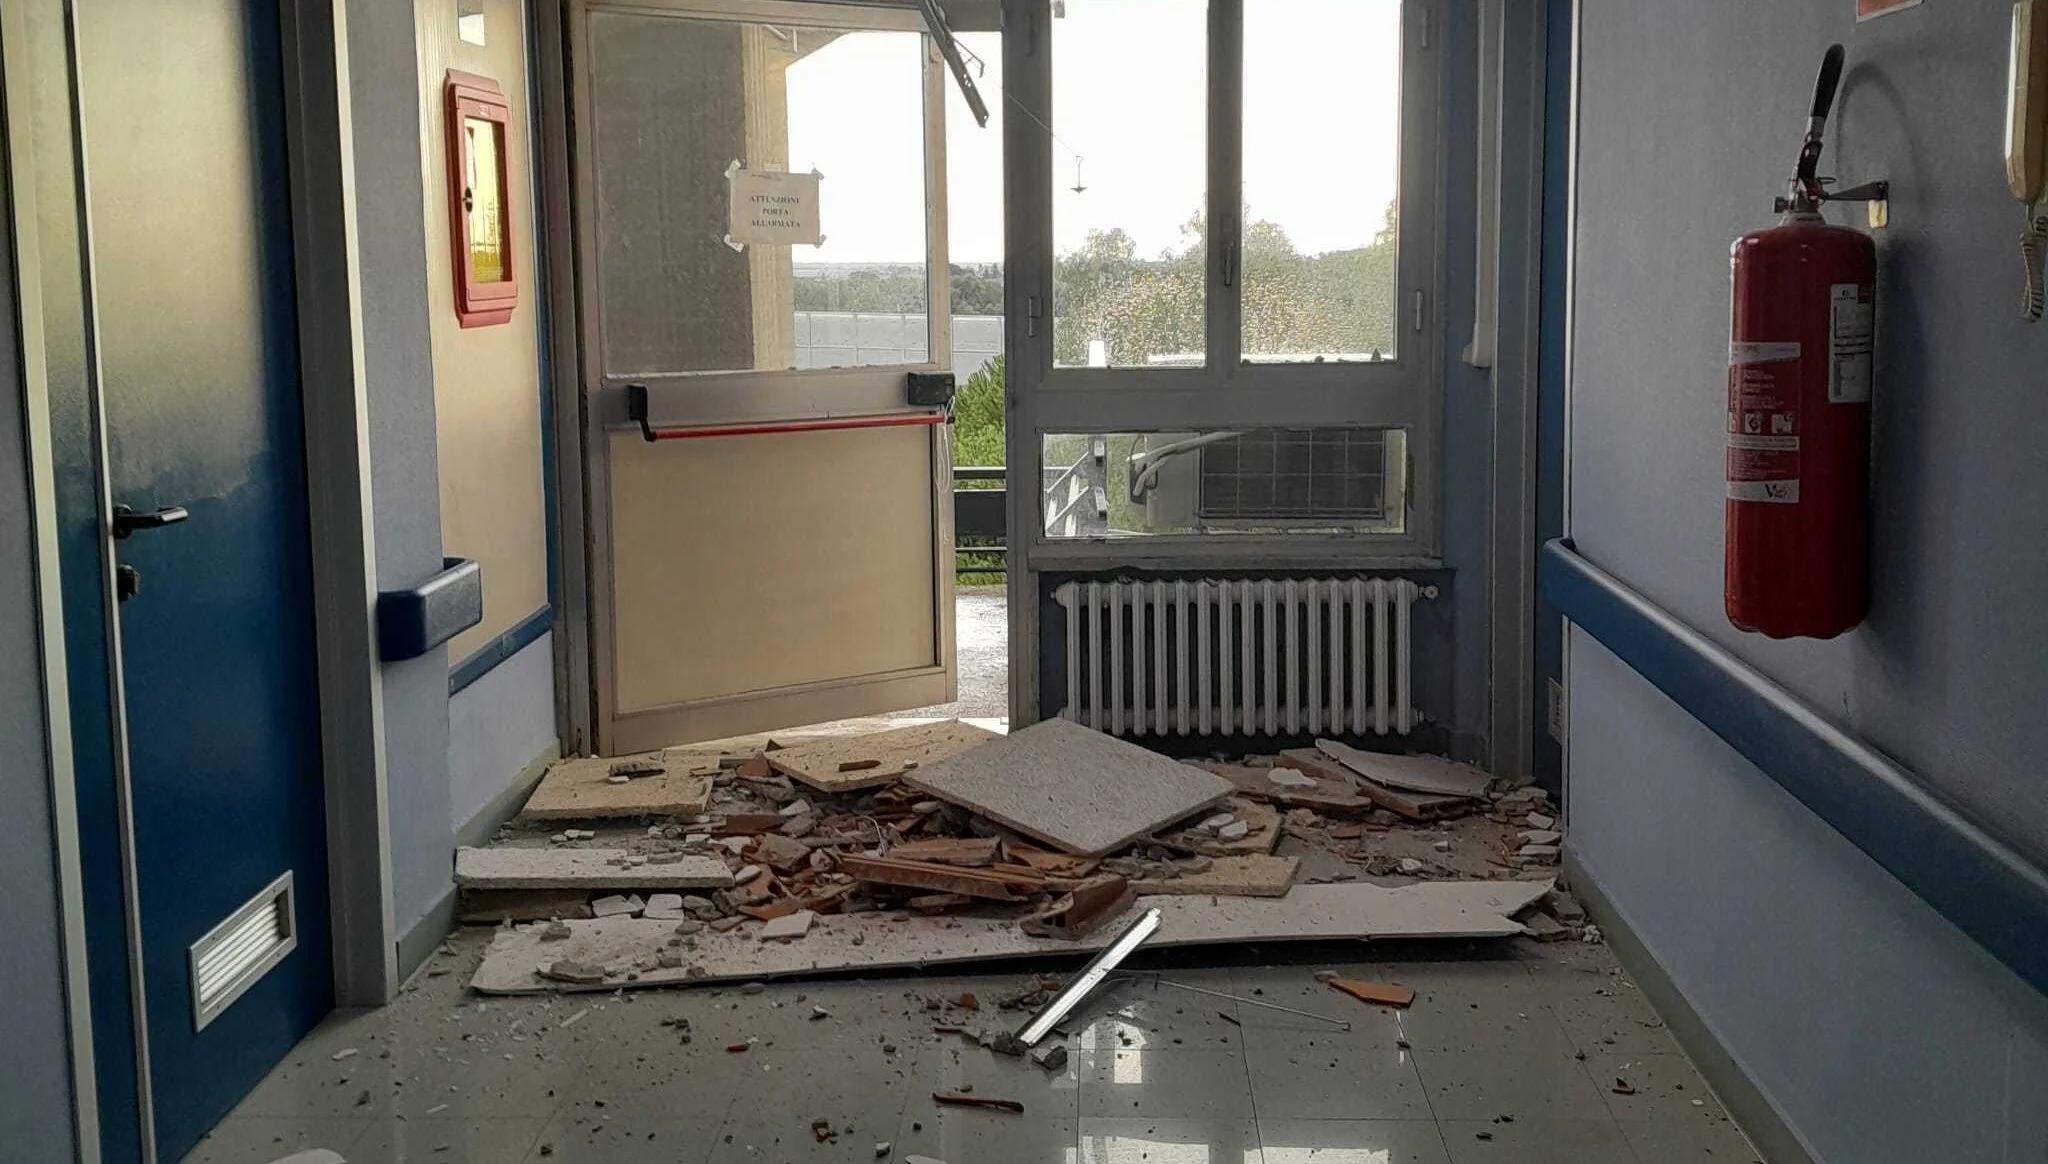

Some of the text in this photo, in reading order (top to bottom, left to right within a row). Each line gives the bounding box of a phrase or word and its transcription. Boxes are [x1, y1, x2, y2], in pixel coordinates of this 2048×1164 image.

[751, 195, 801, 204] ATTENZIONE
[762, 208, 790, 216] PORTA
[751, 219, 801, 228] ALLARMATA
